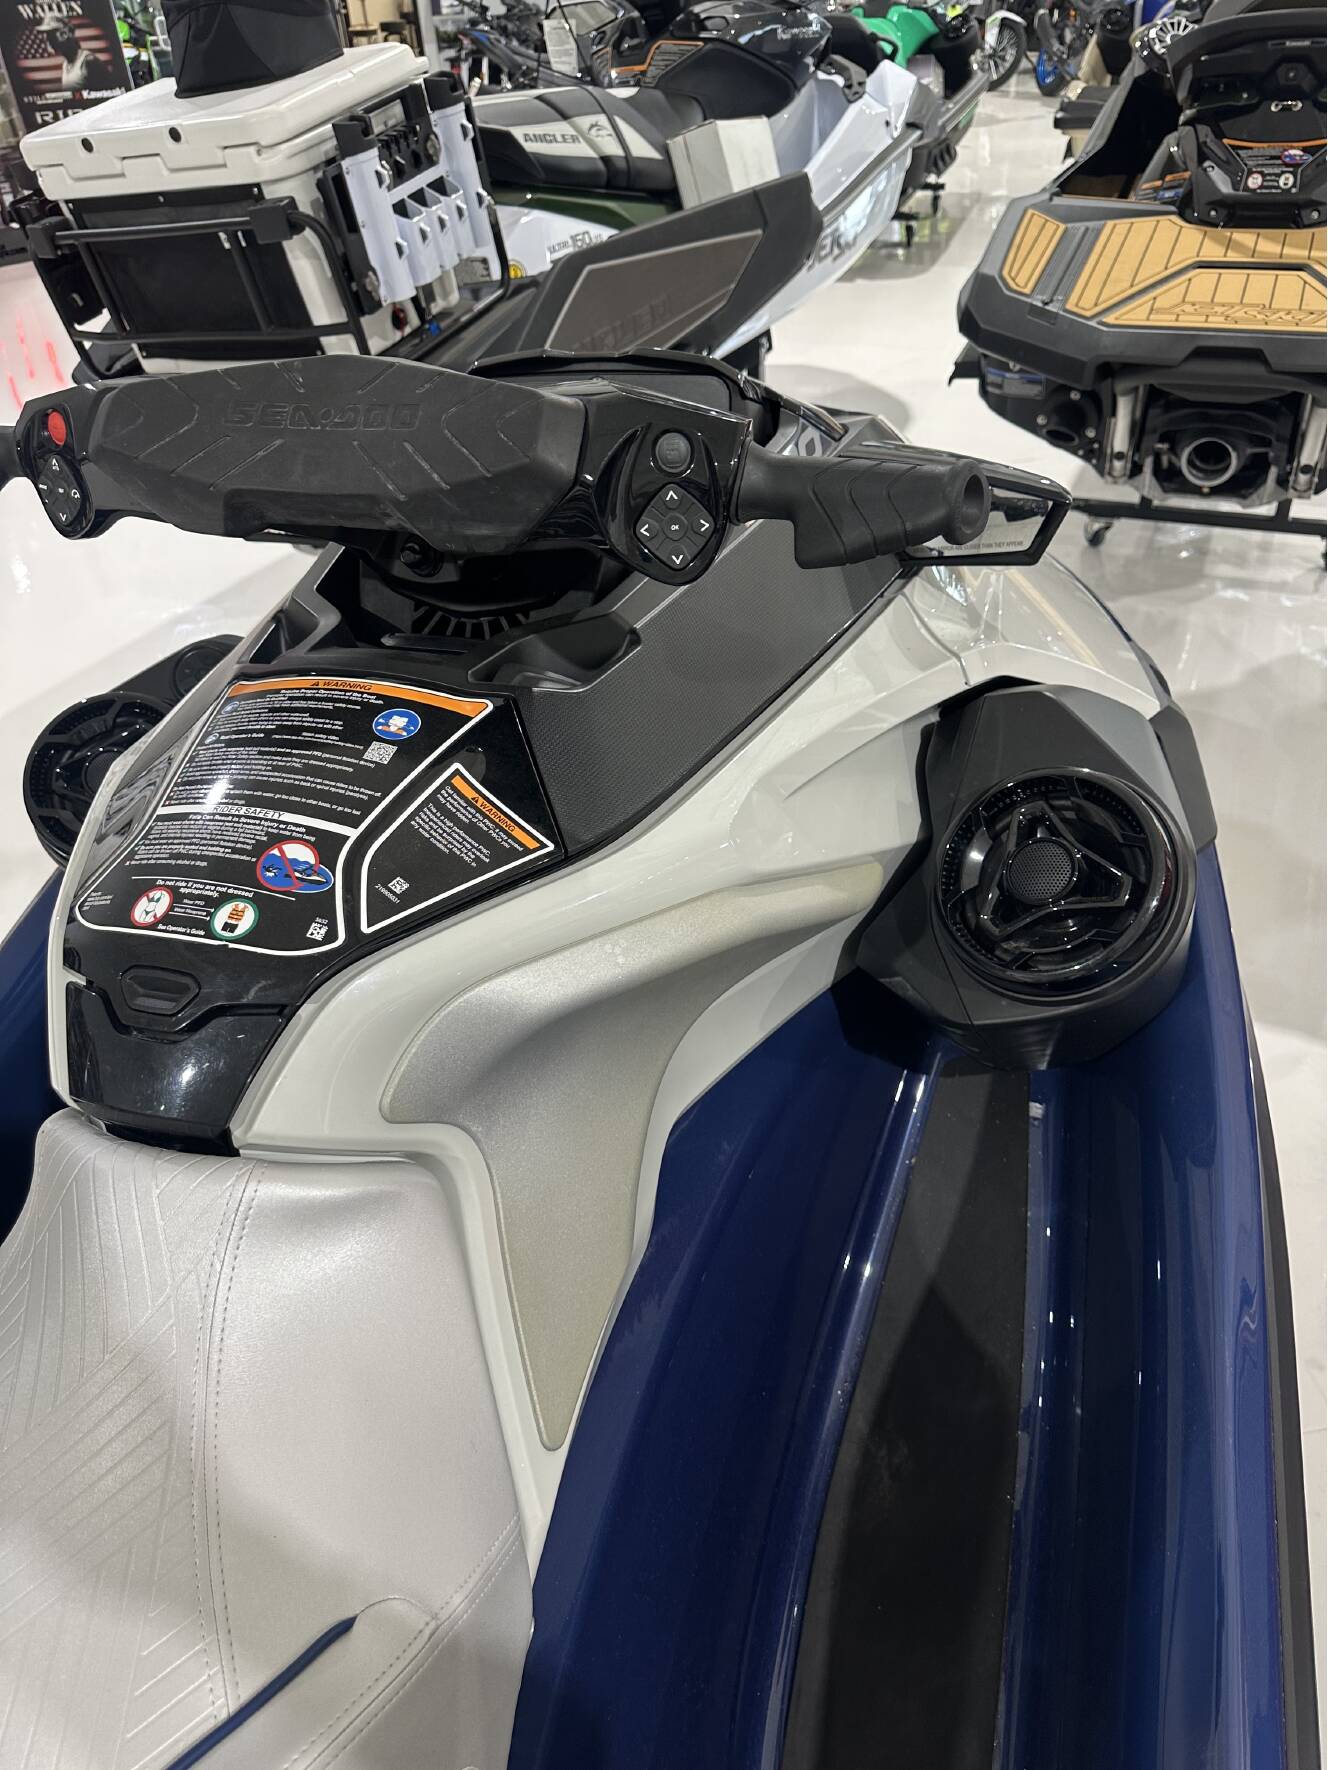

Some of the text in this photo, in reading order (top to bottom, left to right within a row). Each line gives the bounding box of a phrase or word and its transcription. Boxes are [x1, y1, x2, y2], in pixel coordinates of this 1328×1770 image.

[523, 132, 581, 144] ANGLER
[322, 681, 373, 691] WARNING
[213, 805, 285, 820] RIDER SAFETY
[479, 801, 516, 832] WARNING
[216, 884, 227, 892] not
[227, 887, 254, 897] dressed
